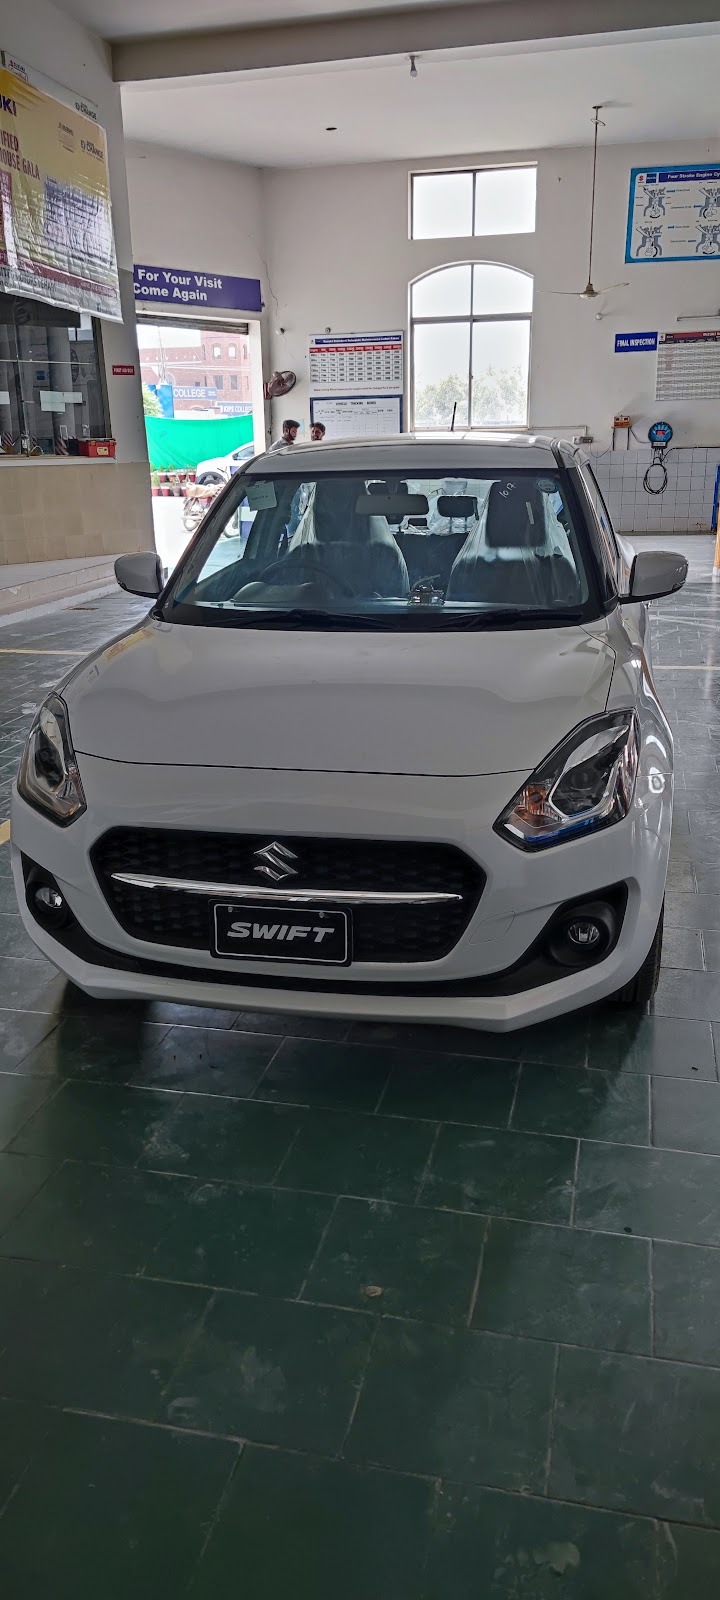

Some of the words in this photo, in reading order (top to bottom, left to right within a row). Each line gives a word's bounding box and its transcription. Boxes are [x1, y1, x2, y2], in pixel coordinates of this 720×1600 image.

[0, 129, 19, 151] IFIED
[22, 158, 40, 180] GALA
[138, 269, 159, 281] For
[162, 272, 191, 286] Your
[194, 276, 222, 289] Visit
[133, 283, 168, 296] Come
[173, 288, 207, 301] Again
[617, 339, 629, 347] FINAL
[630, 338, 656, 347] INSPECTION
[173, 388, 206, 398] COLLEGE
[235, 406, 253, 414] COLLEG
[227, 922, 335, 943] SWIFT
